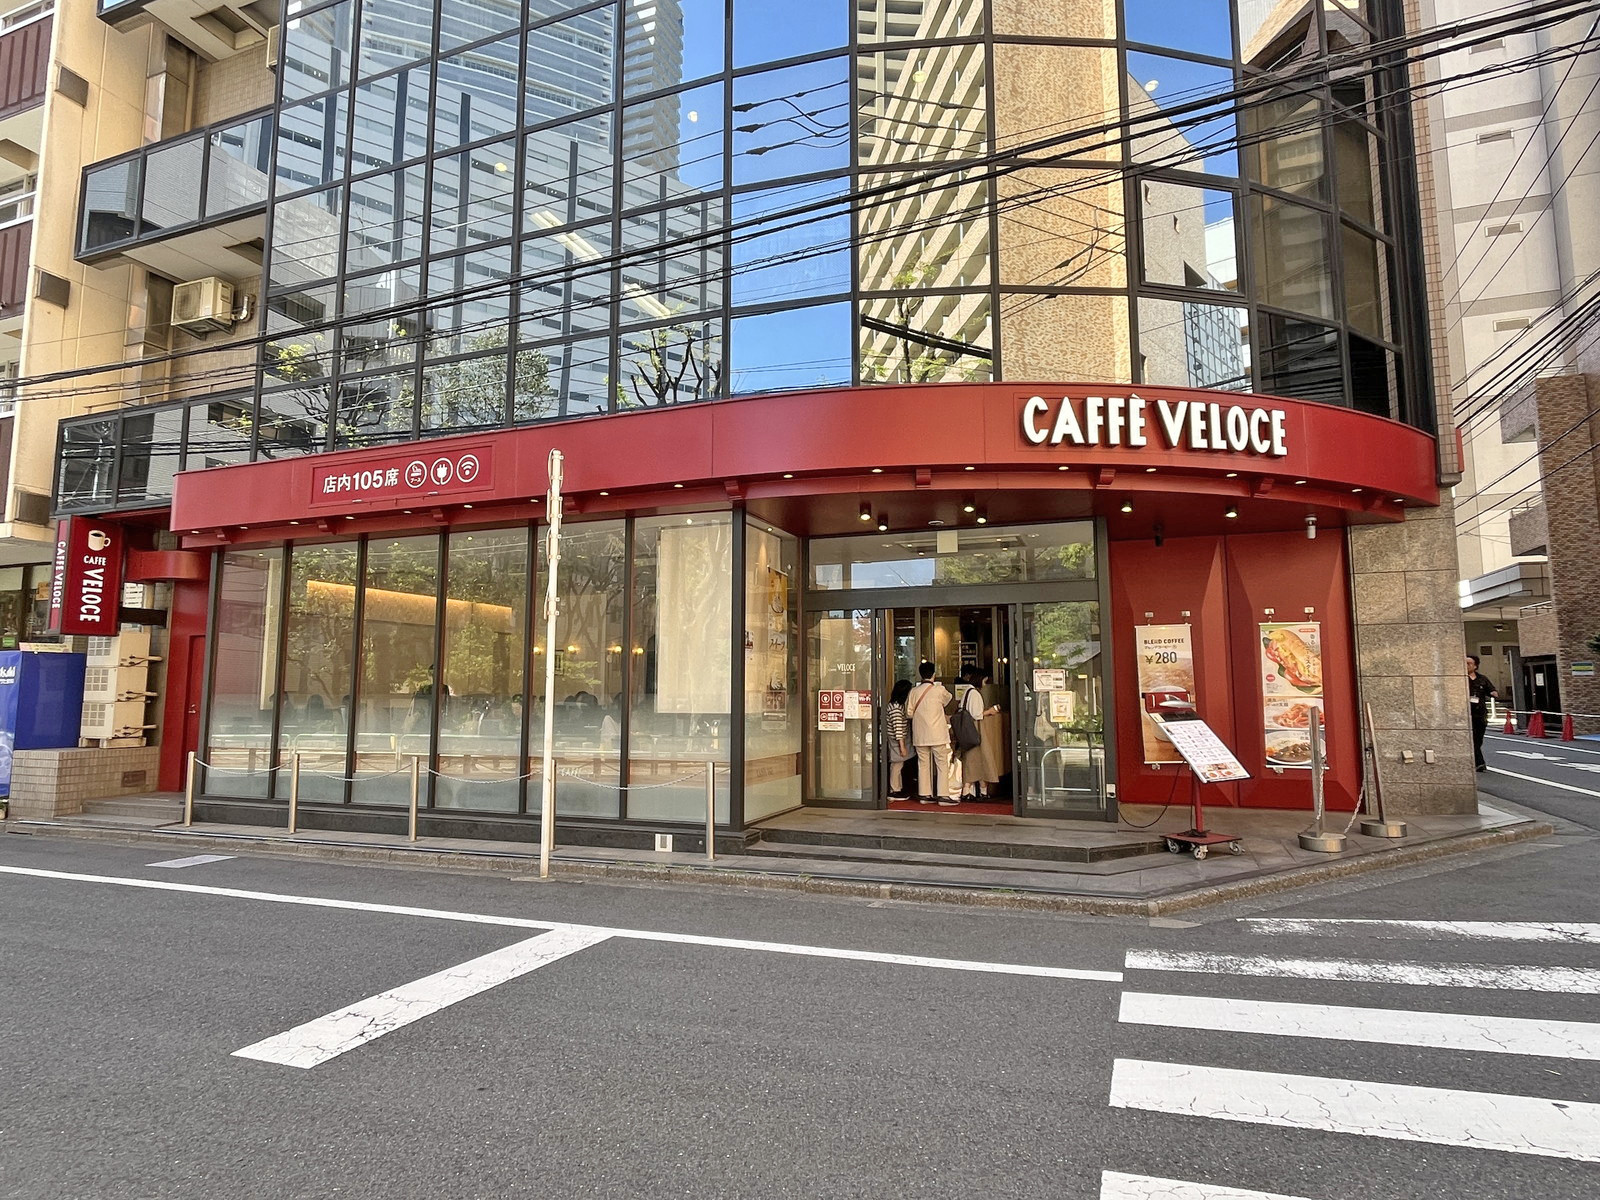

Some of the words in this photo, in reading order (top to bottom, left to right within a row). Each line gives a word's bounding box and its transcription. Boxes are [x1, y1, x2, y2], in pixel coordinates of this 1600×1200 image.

[1023, 393, 1147, 446] CAFFÈ
[1156, 400, 1288, 456] VELOCE
[323, 468, 399, 494] 店内105席
[51, 573, 64, 609] VELOCE
[79, 568, 105, 622] VELOCE
[837, 663, 856, 672] VELOCE
[1145, 651, 1178, 664] ¥280
